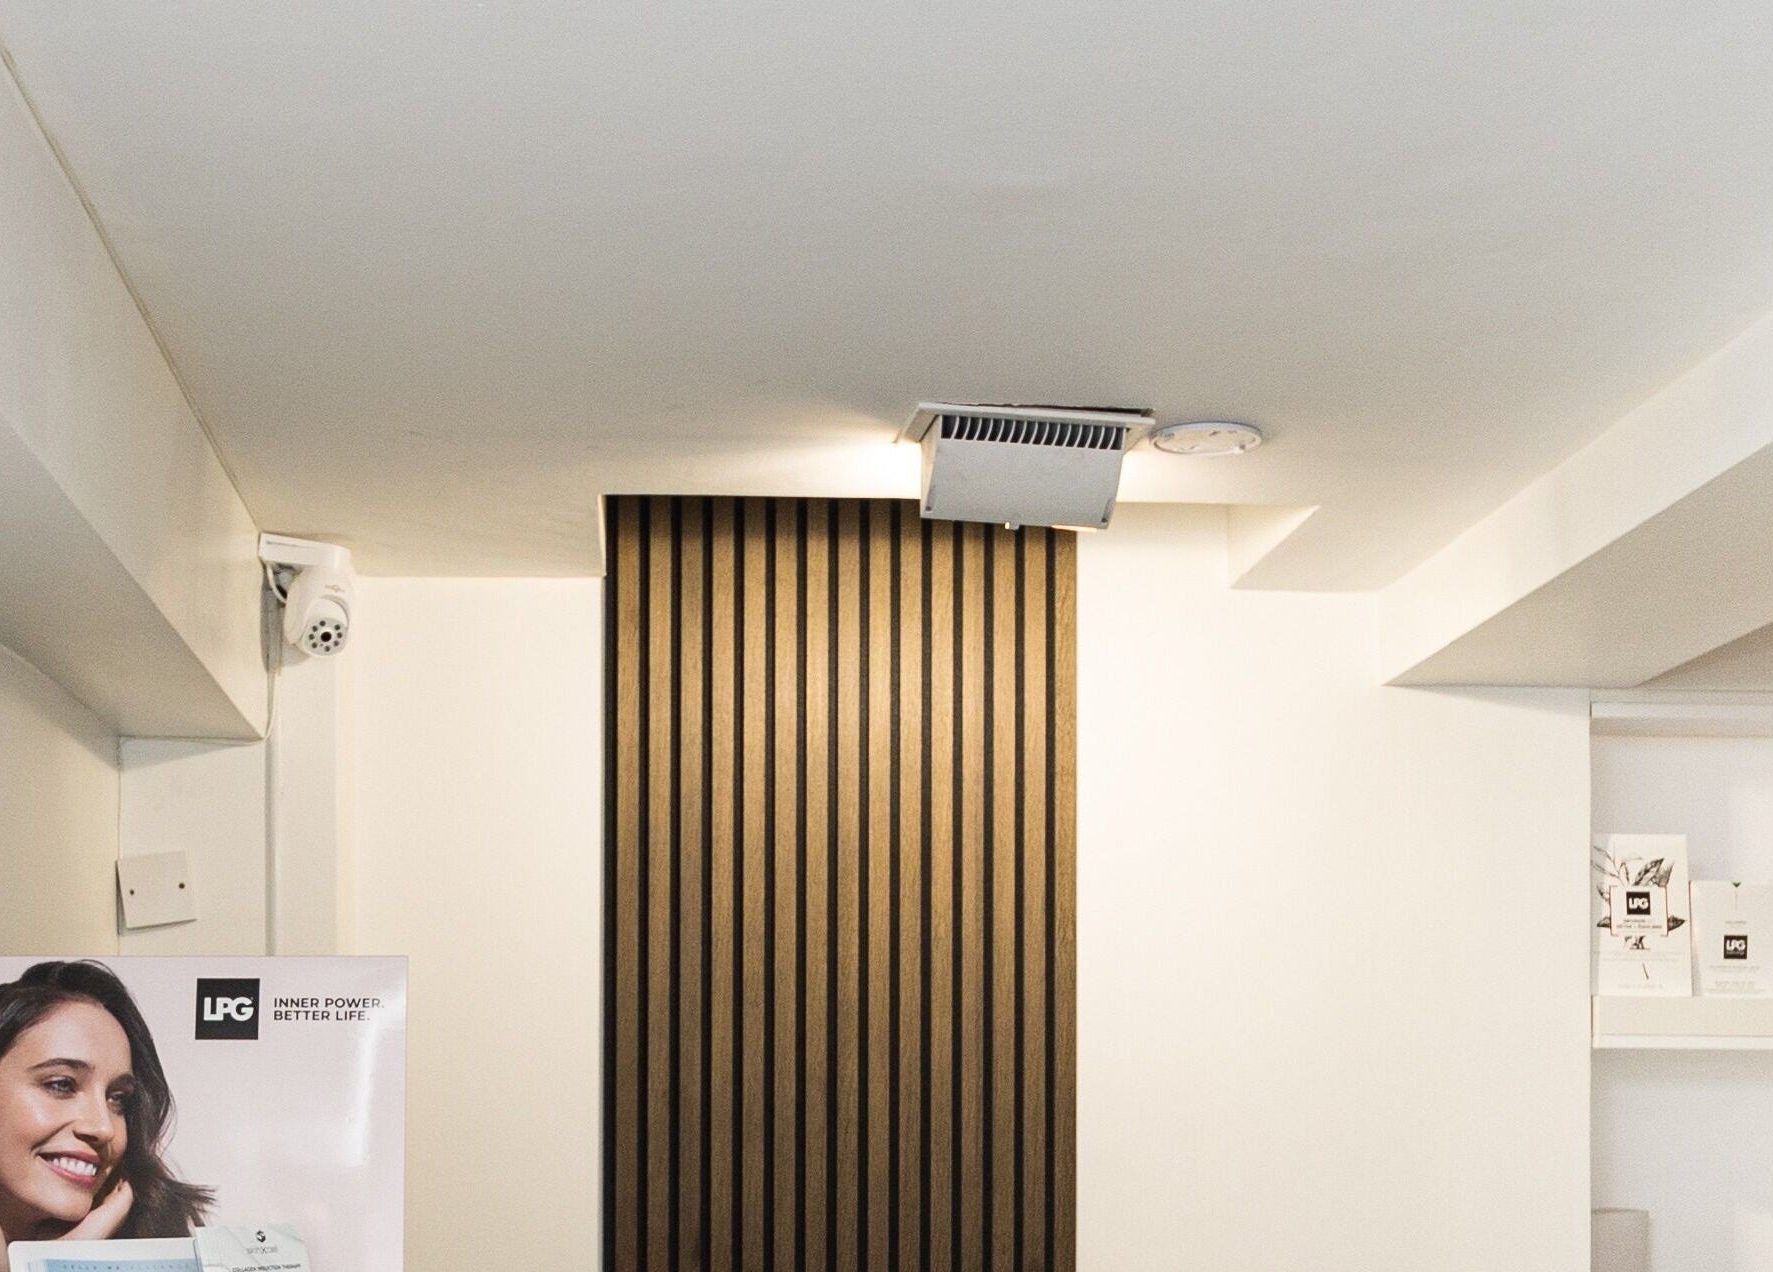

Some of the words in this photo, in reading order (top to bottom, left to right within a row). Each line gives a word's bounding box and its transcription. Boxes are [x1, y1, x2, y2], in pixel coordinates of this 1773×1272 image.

[203, 996, 254, 1022] LPG
[273, 997, 319, 1009] INNER
[324, 997, 385, 1009] POWER.
[273, 1010, 331, 1021] BETTER
[335, 1010, 370, 1021] LIFE.
